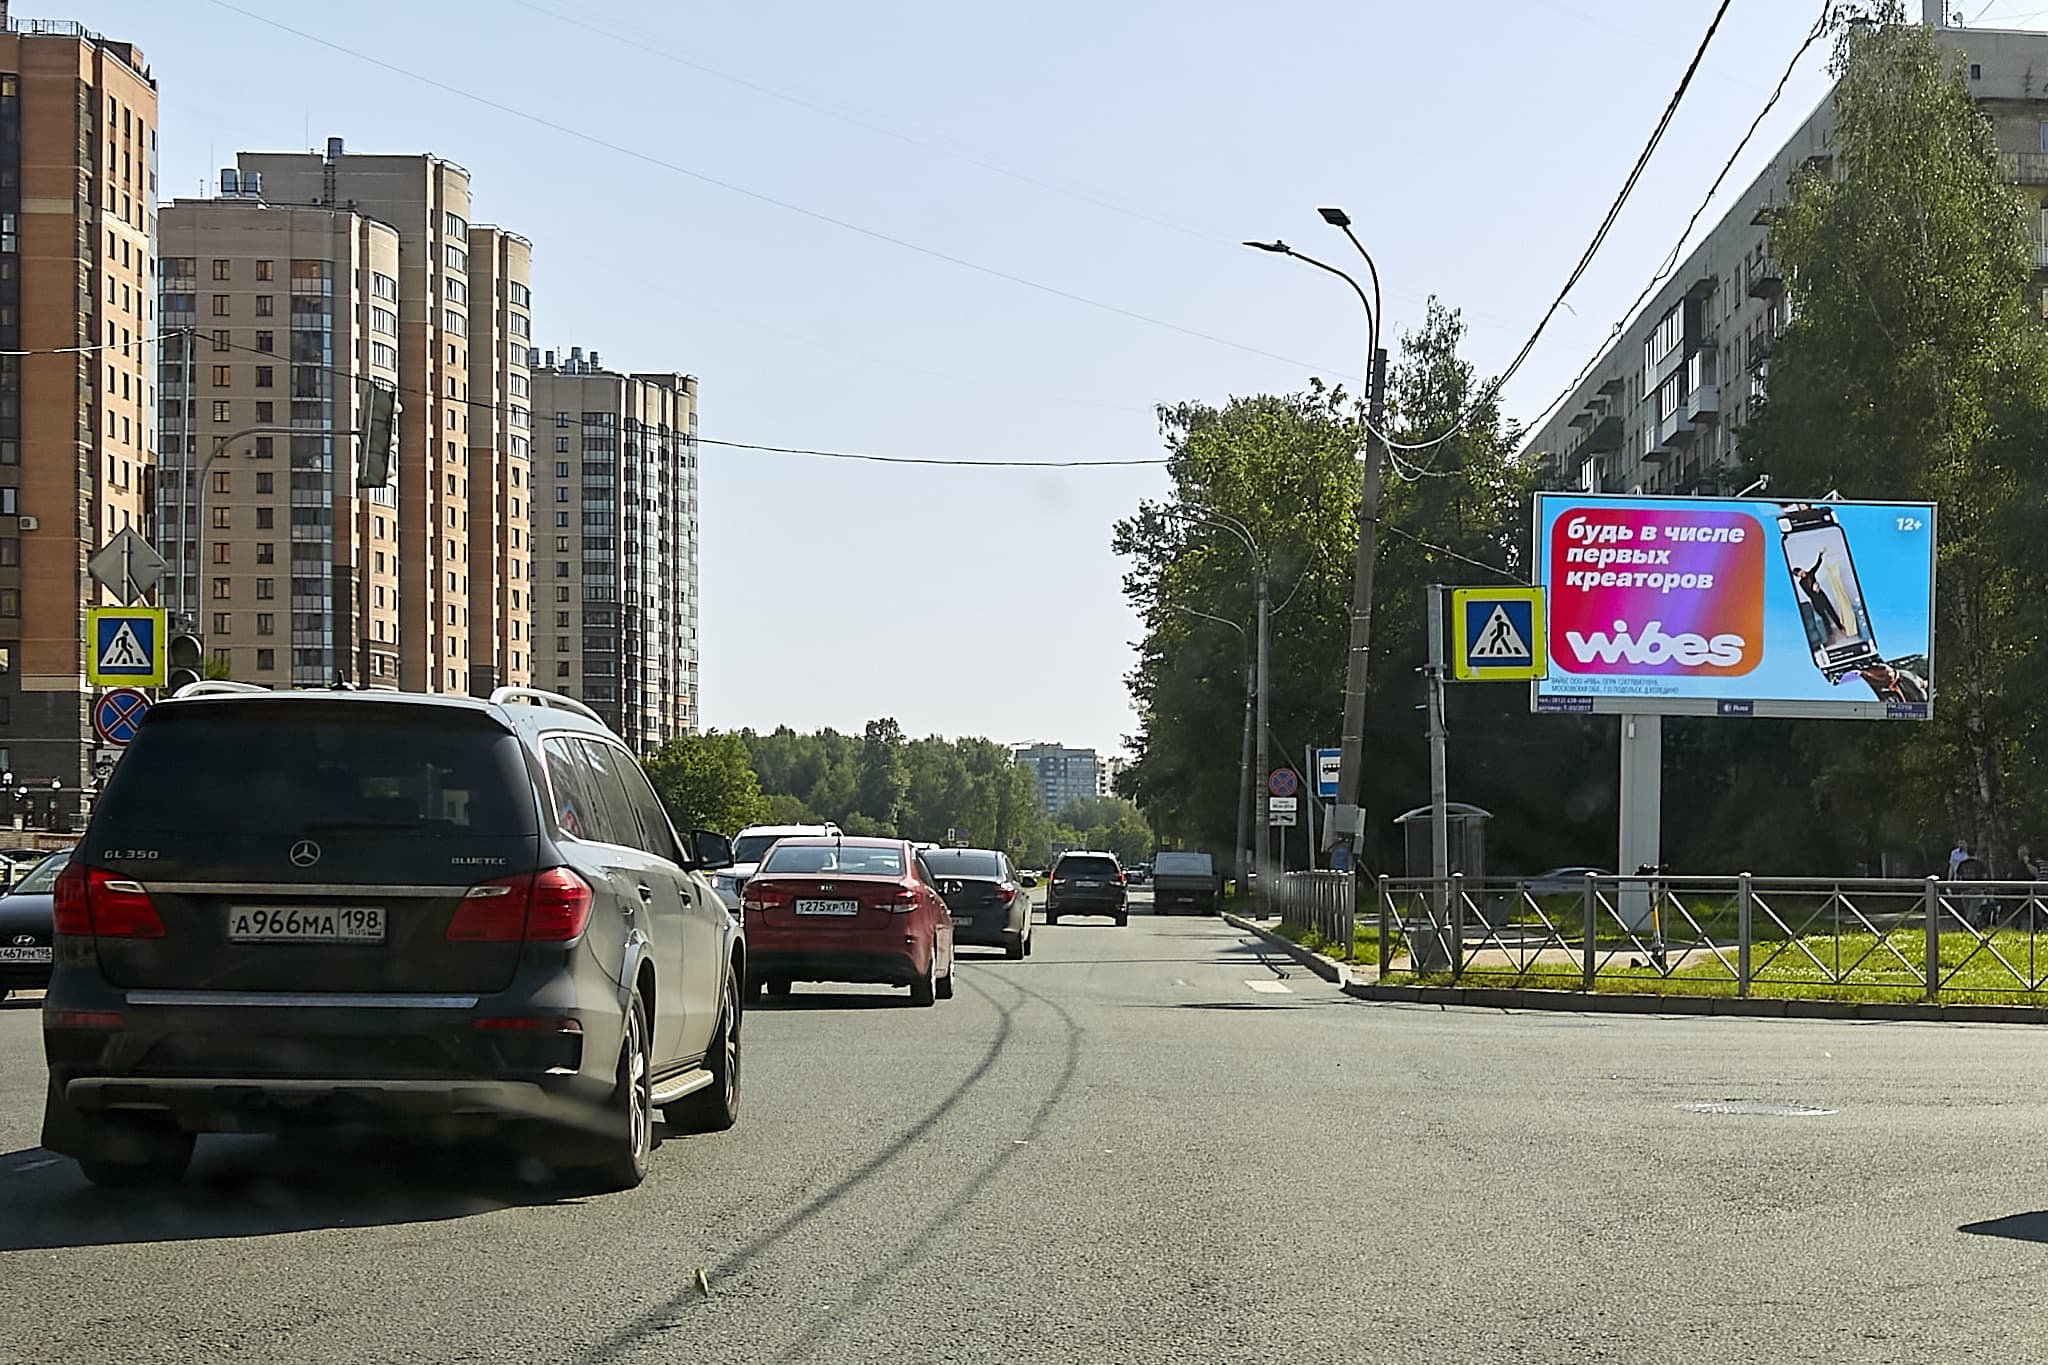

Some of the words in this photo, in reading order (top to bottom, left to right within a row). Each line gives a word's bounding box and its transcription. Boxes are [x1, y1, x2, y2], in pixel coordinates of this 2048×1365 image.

[1567, 516, 1633, 545] будь
[1639, 526, 1657, 541] в
[1664, 526, 1745, 543] числе
[1896, 517, 1922, 531] 12+
[1566, 547, 1671, 569] первых
[1566, 571, 1714, 594] креаторов
[104, 849, 122, 859] GL
[126, 849, 159, 860] 350
[341, 910, 378, 929] 198
